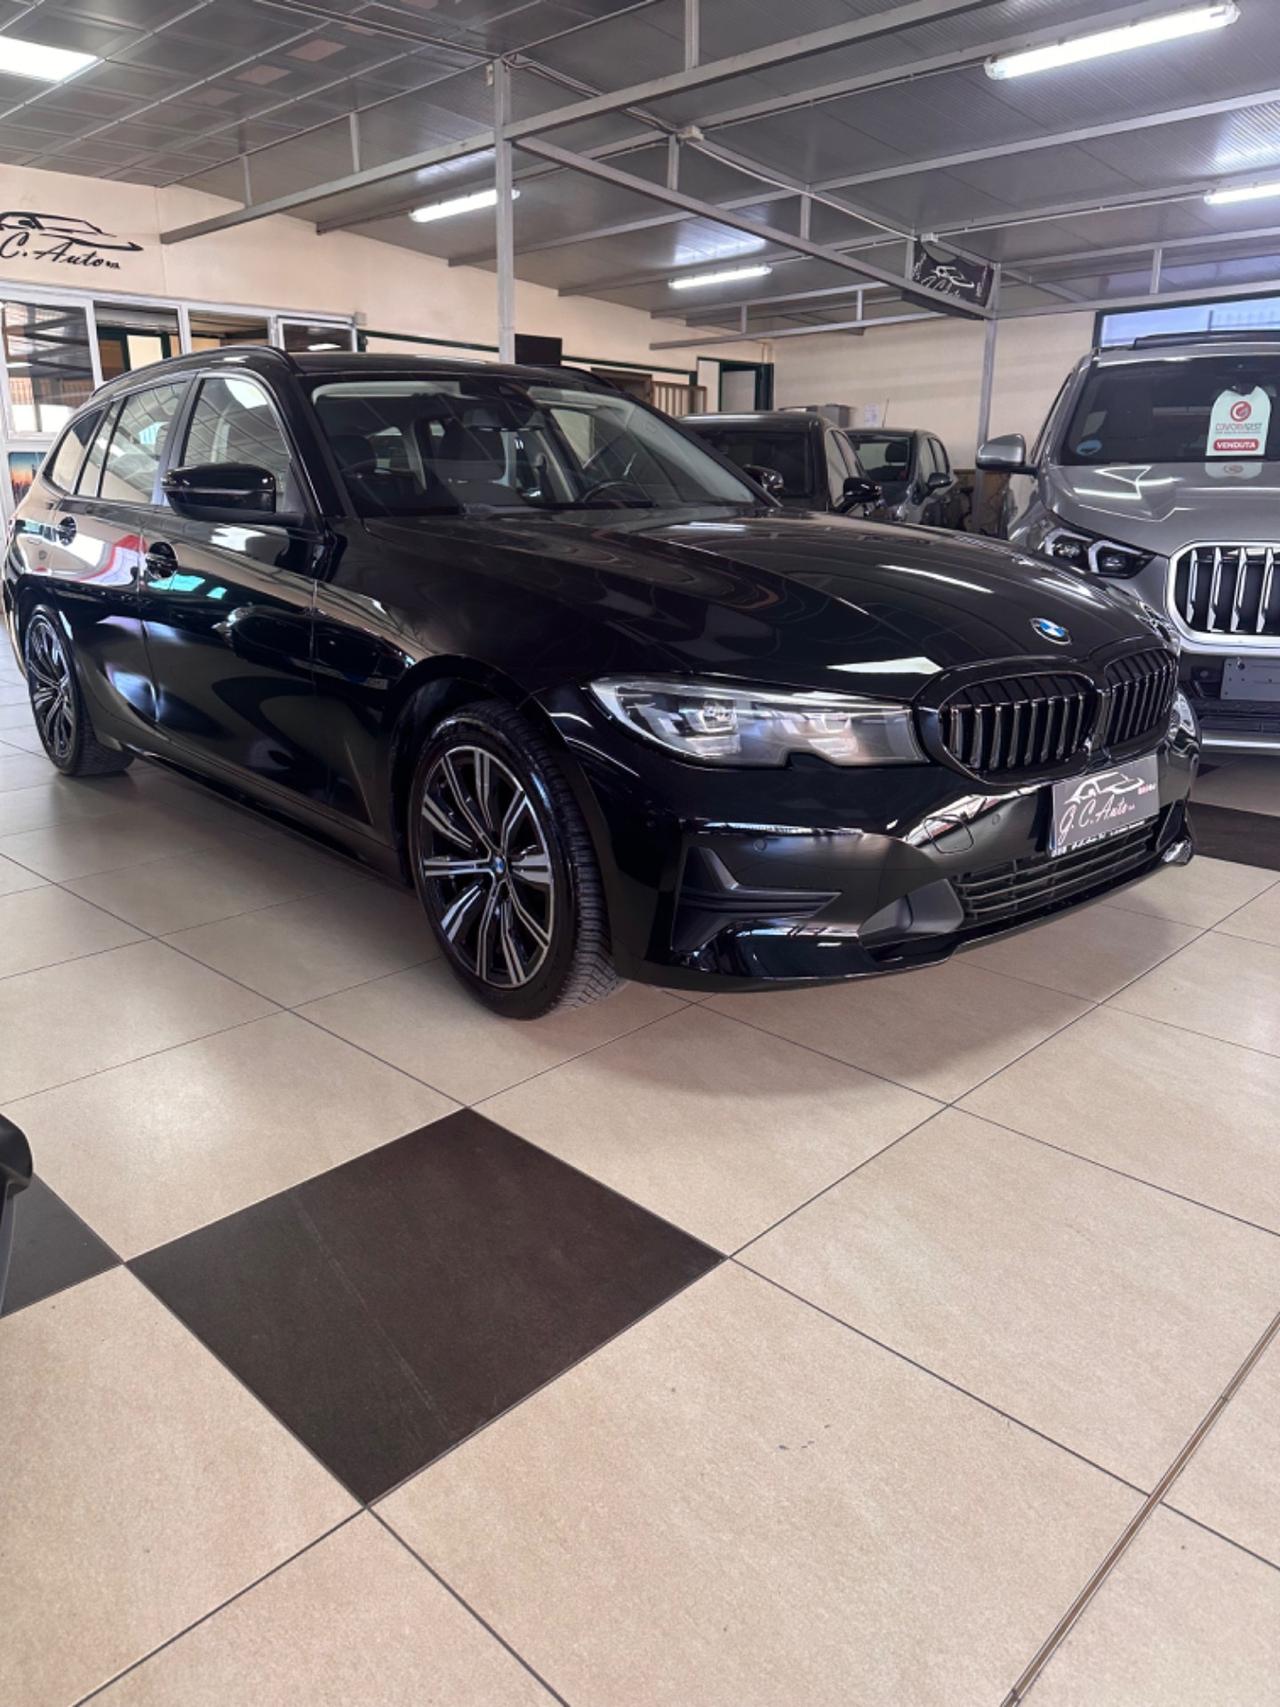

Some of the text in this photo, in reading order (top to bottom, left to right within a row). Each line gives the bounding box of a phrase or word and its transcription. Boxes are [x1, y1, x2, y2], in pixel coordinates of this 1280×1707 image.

[33, 240, 104, 268] Auto
[1216, 441, 1256, 449] VENDUTA
[1095, 794, 1128, 821] Auto
